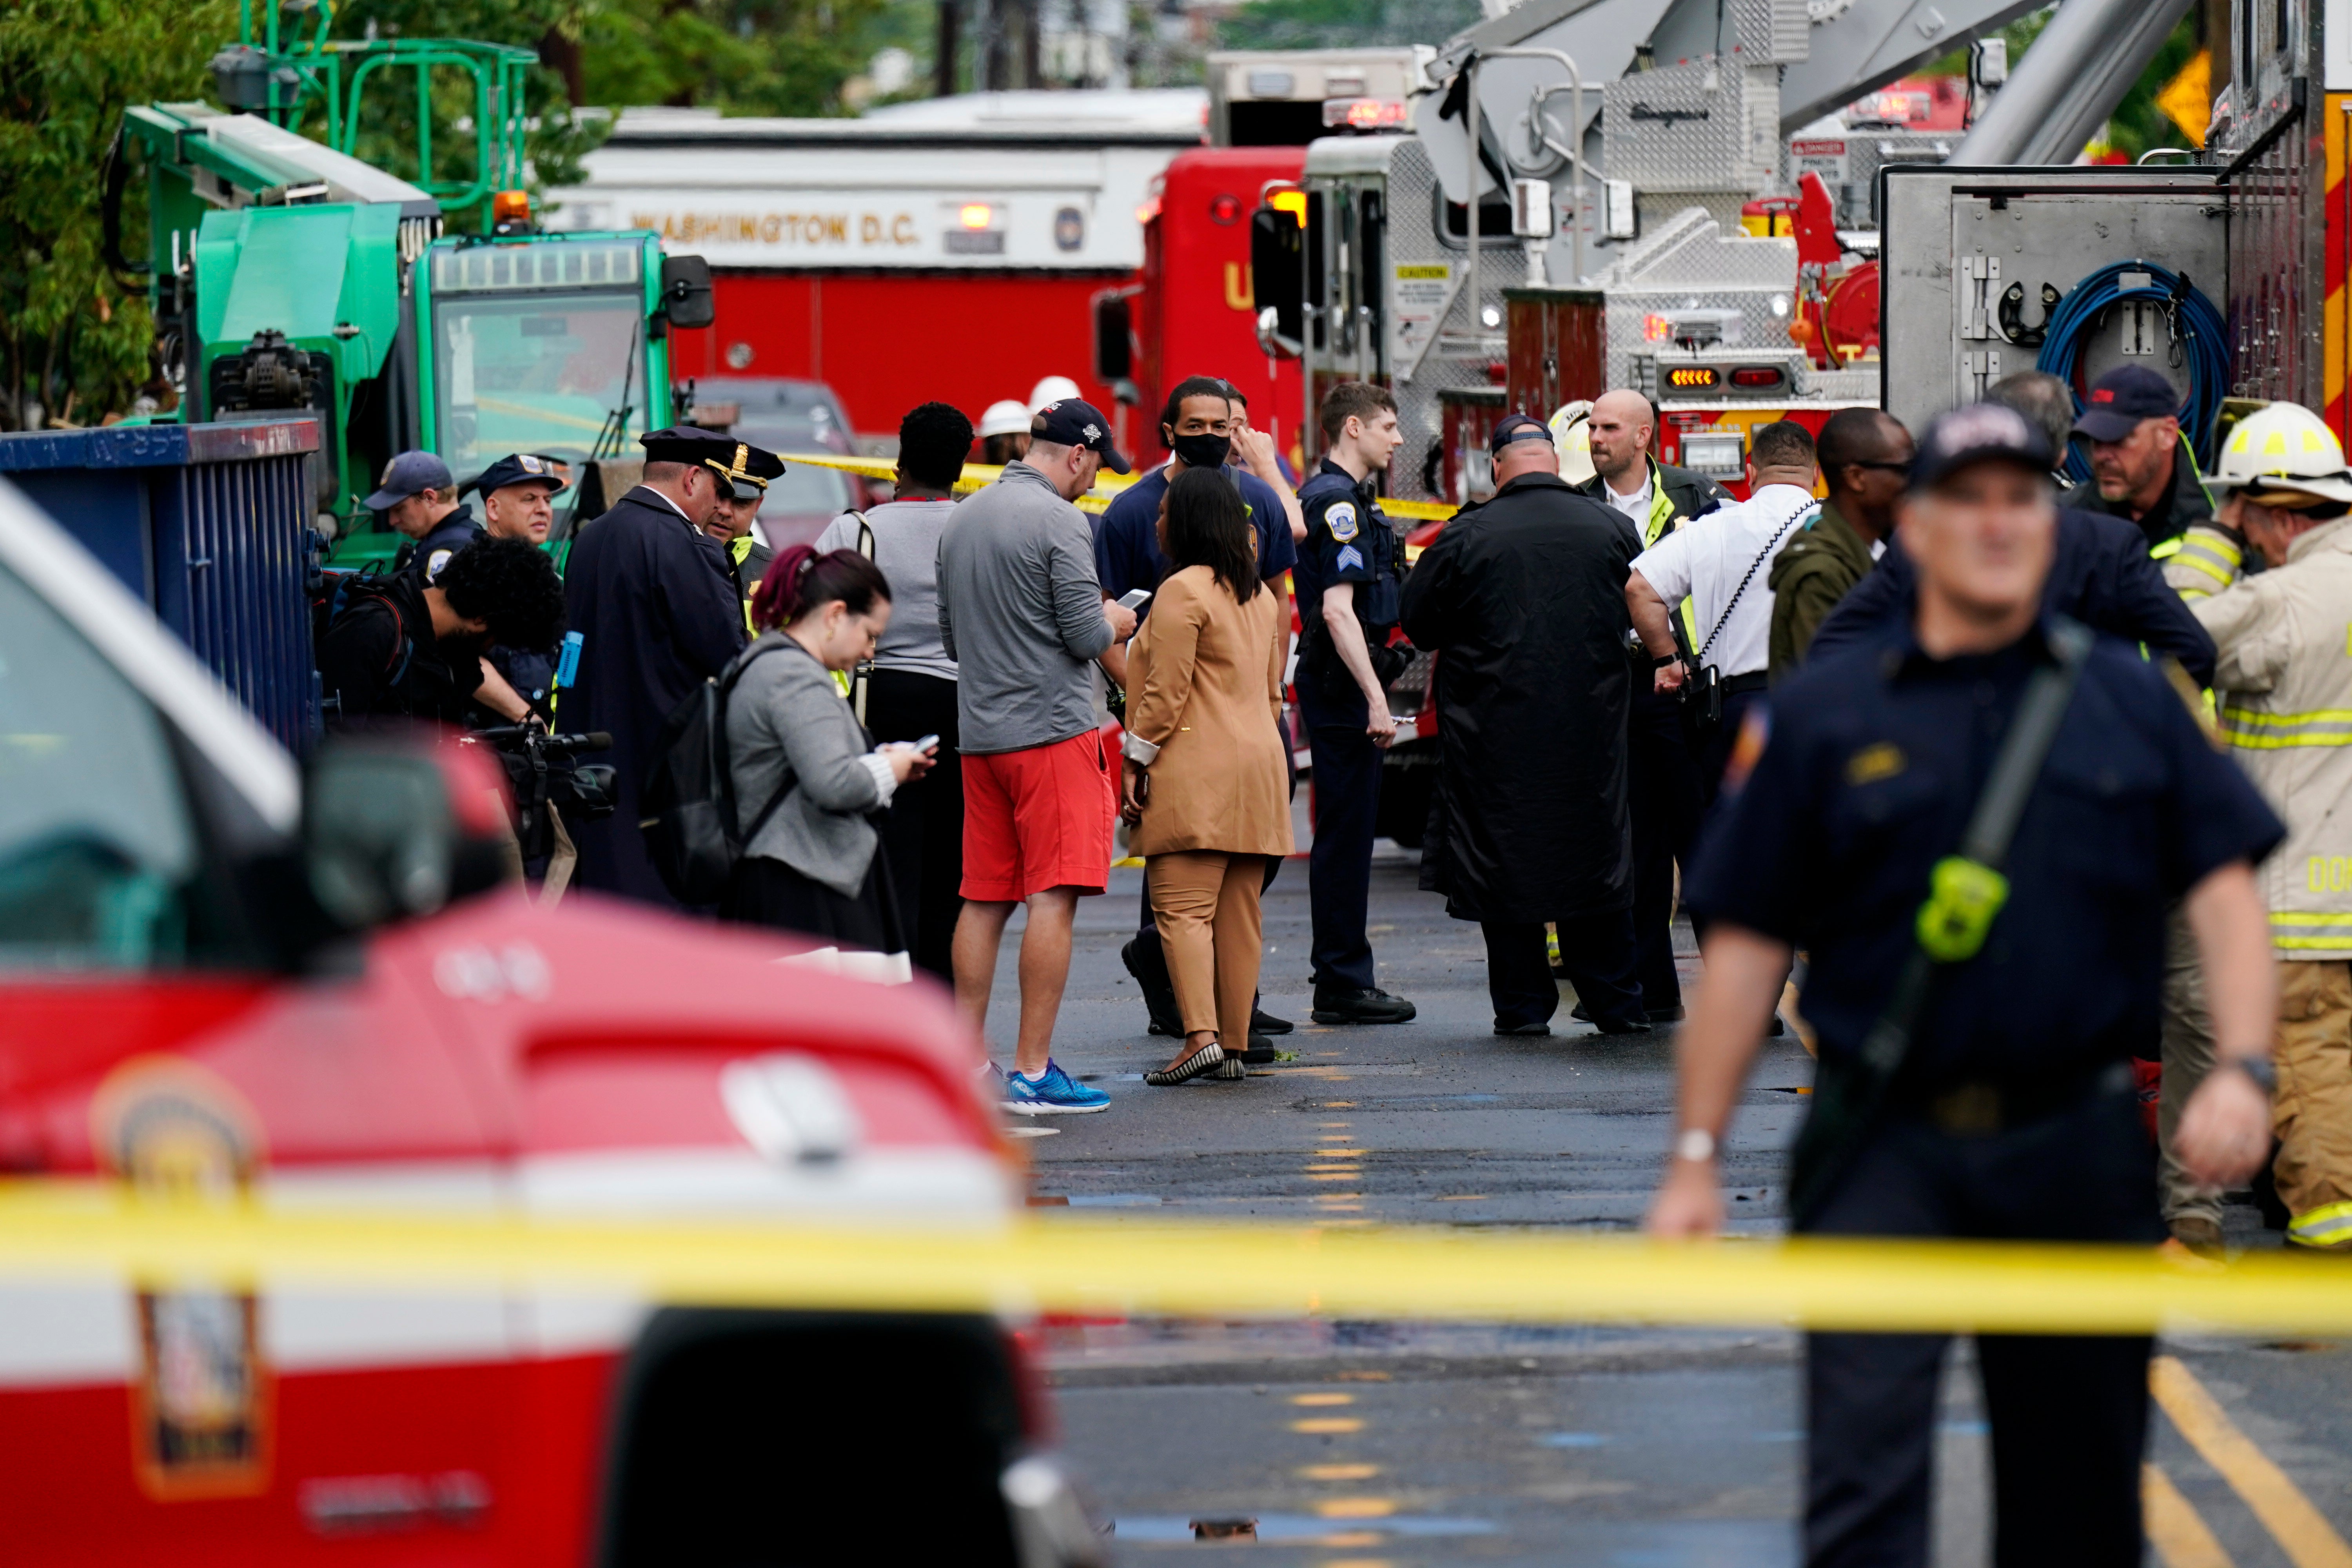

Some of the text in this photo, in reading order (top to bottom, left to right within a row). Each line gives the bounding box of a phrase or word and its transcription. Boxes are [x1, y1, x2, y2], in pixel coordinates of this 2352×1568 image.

[1804, 143, 1842, 152] DANGER
[631, 214, 846, 243] WASHINGTON
[862, 214, 917, 244] D.C.
[1400, 267, 1446, 278] CAUTION
[1012, 1078, 1036, 1098] HOKA
